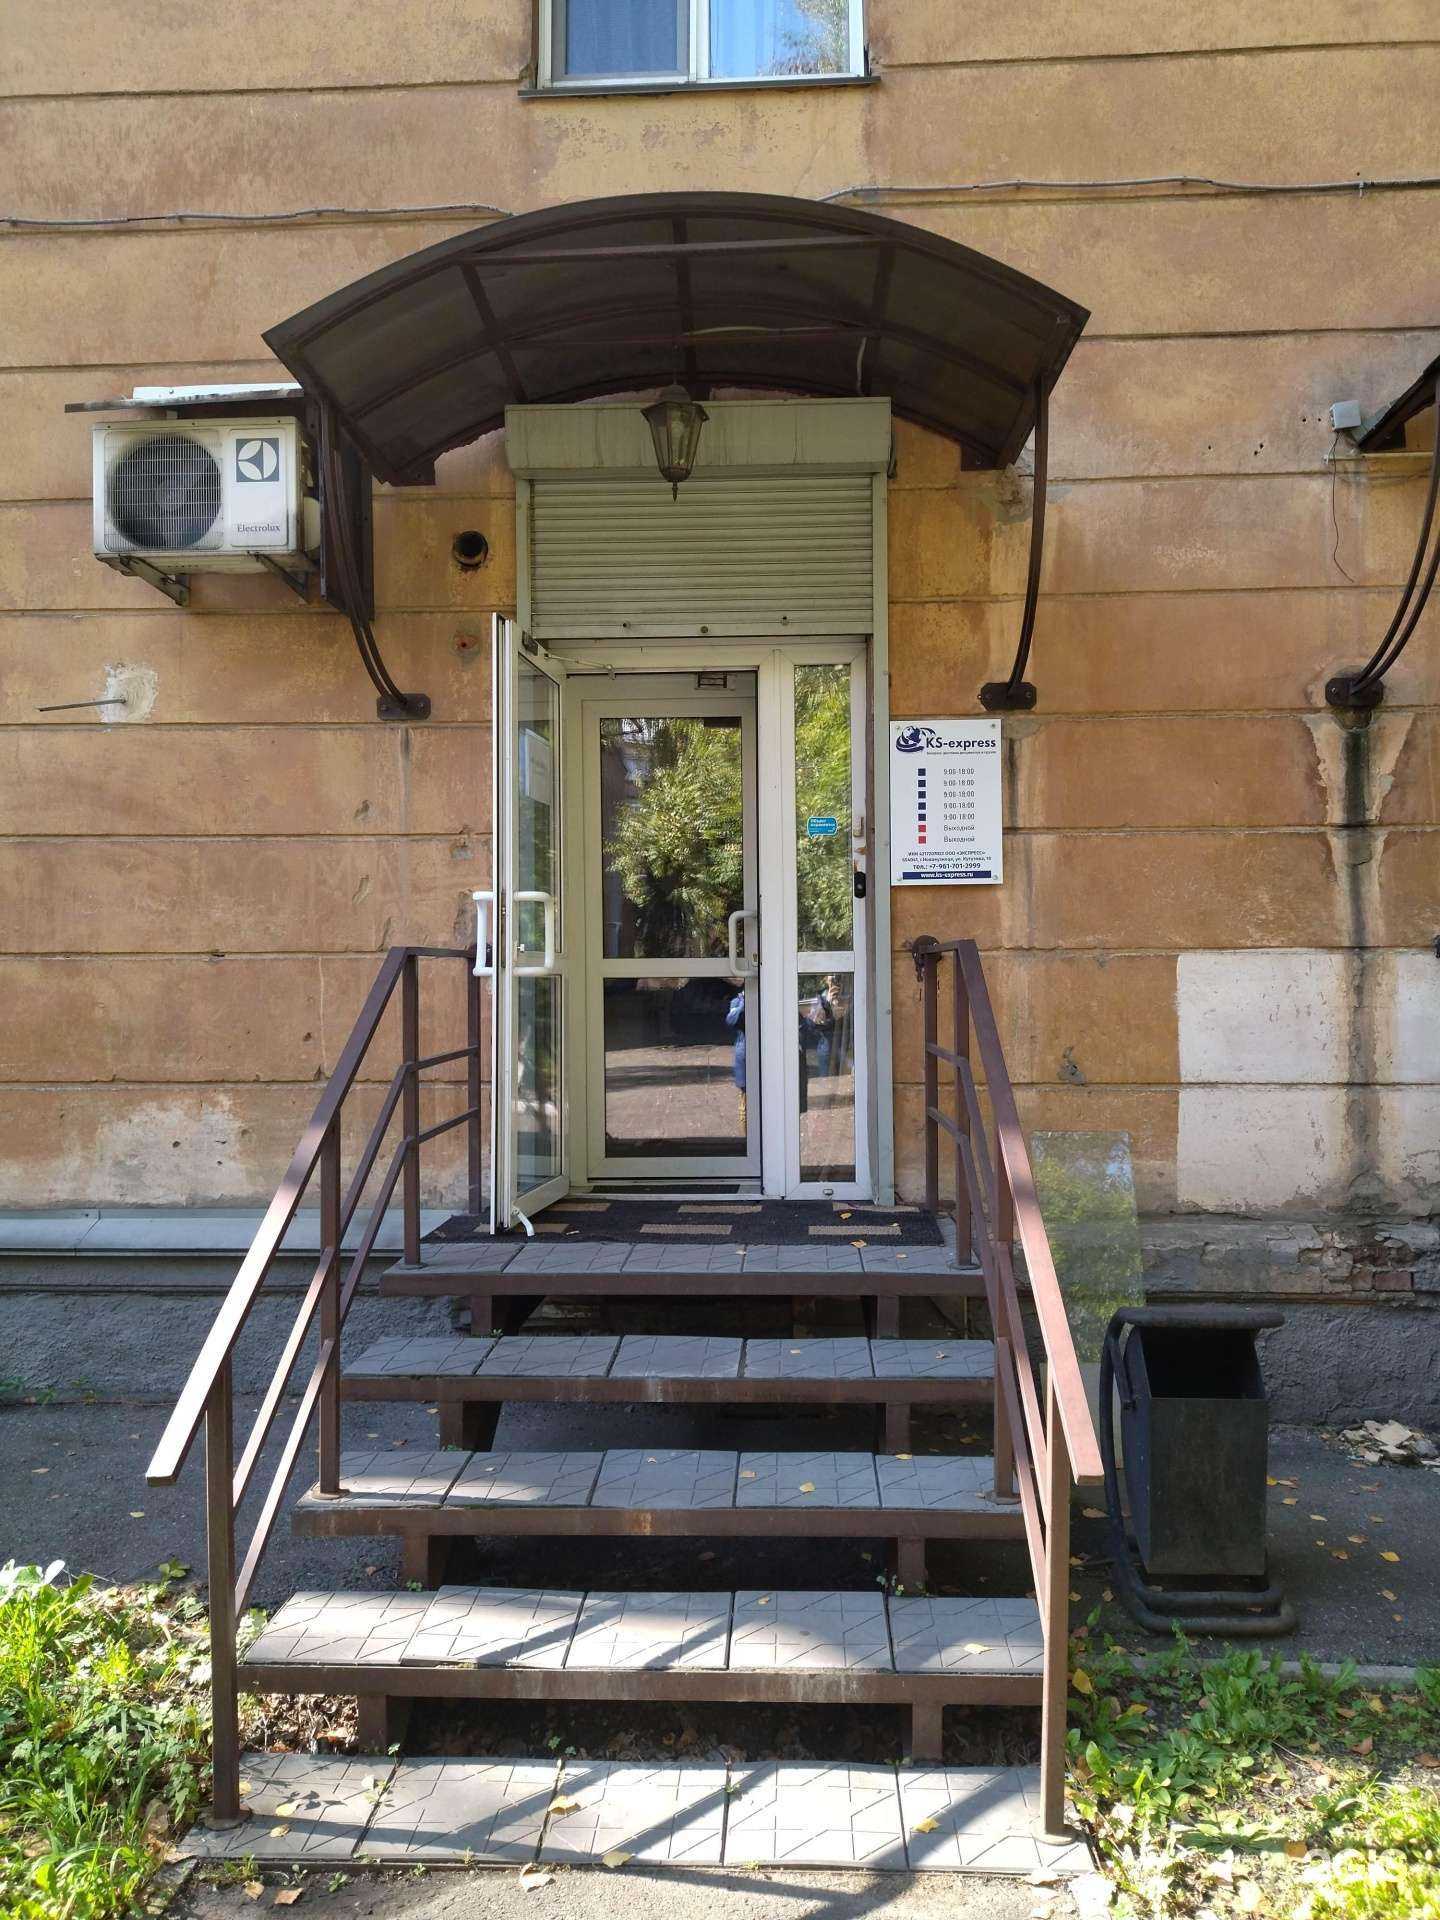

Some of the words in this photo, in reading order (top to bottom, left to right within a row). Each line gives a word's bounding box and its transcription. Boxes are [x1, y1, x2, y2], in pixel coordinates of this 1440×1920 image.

[237, 523, 281, 533] Electrolux
[926, 737, 997, 751] KS-express
[943, 824, 975, 832] Выходной
